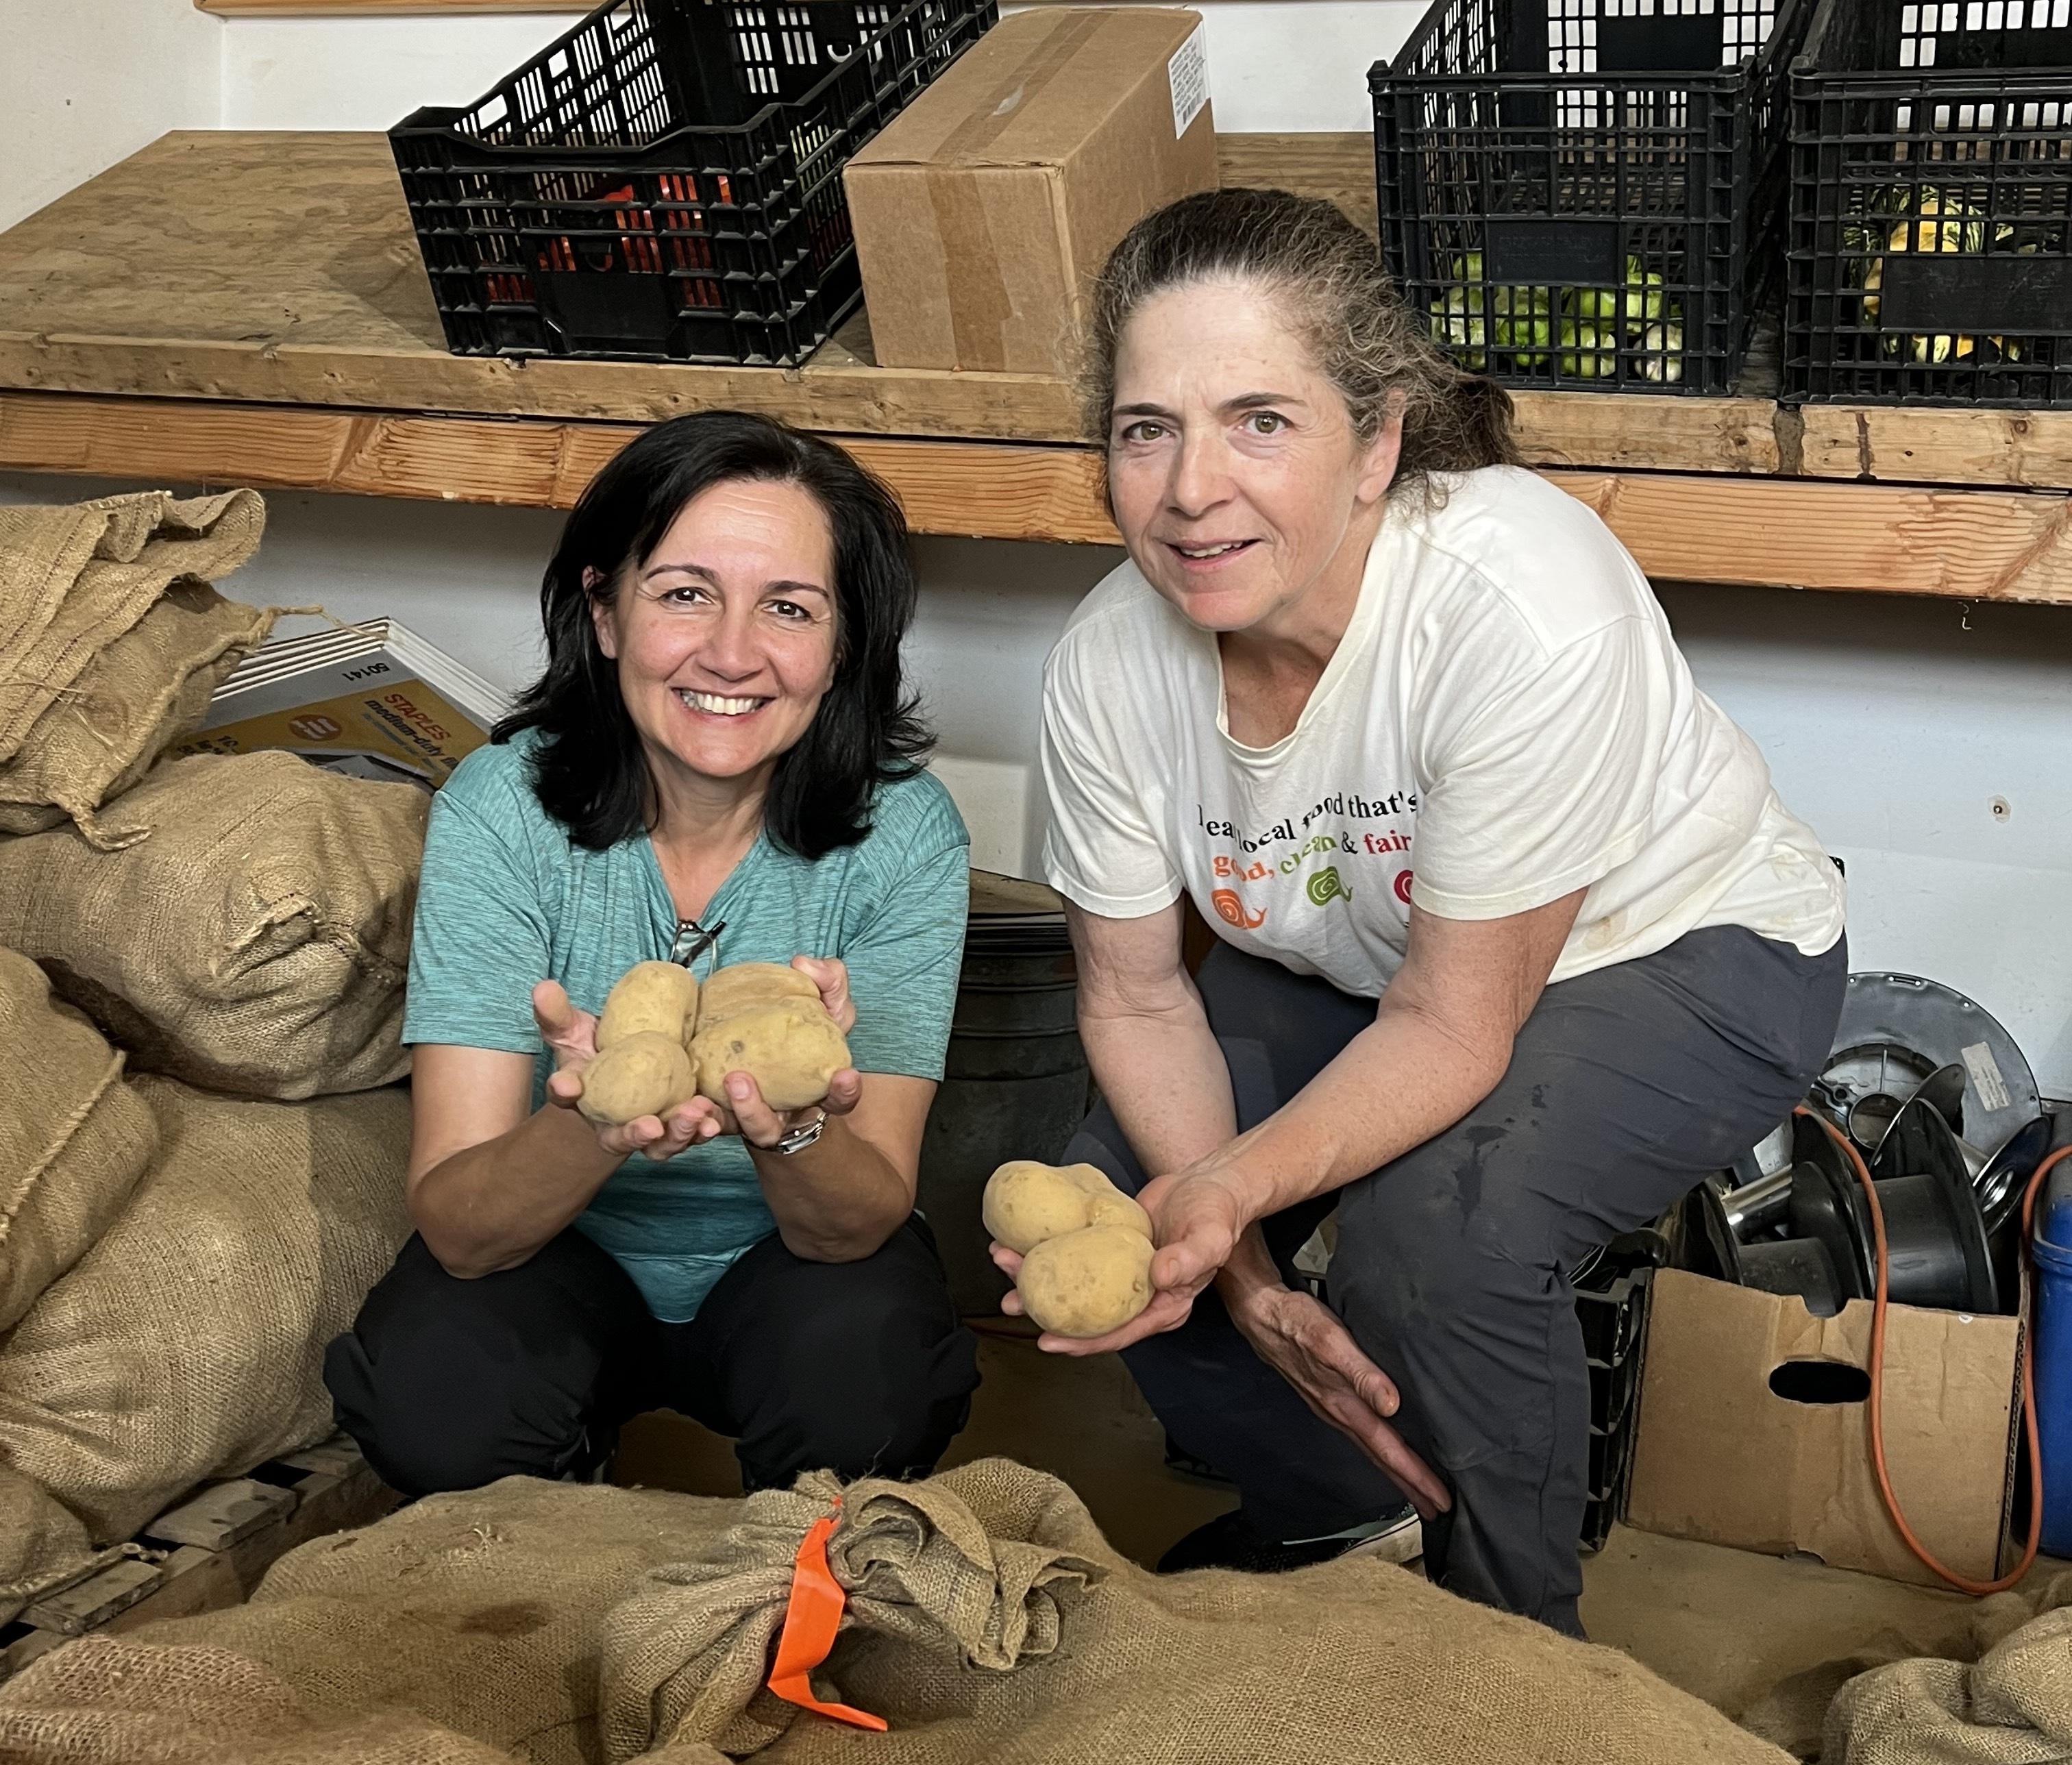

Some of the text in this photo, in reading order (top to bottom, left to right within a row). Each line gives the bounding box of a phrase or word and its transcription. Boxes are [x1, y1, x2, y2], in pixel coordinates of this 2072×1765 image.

[343, 663, 390, 682] 50141
[365, 700, 444, 758] medium-duty
[384, 693, 451, 741] STAPLES
[1237, 819, 1297, 853] local
[1302, 792, 1344, 830] food
[1348, 791, 1417, 818] that's
[1280, 836, 1337, 874] clean
[1342, 830, 1358, 854] &
[1364, 829, 1411, 855] fair
